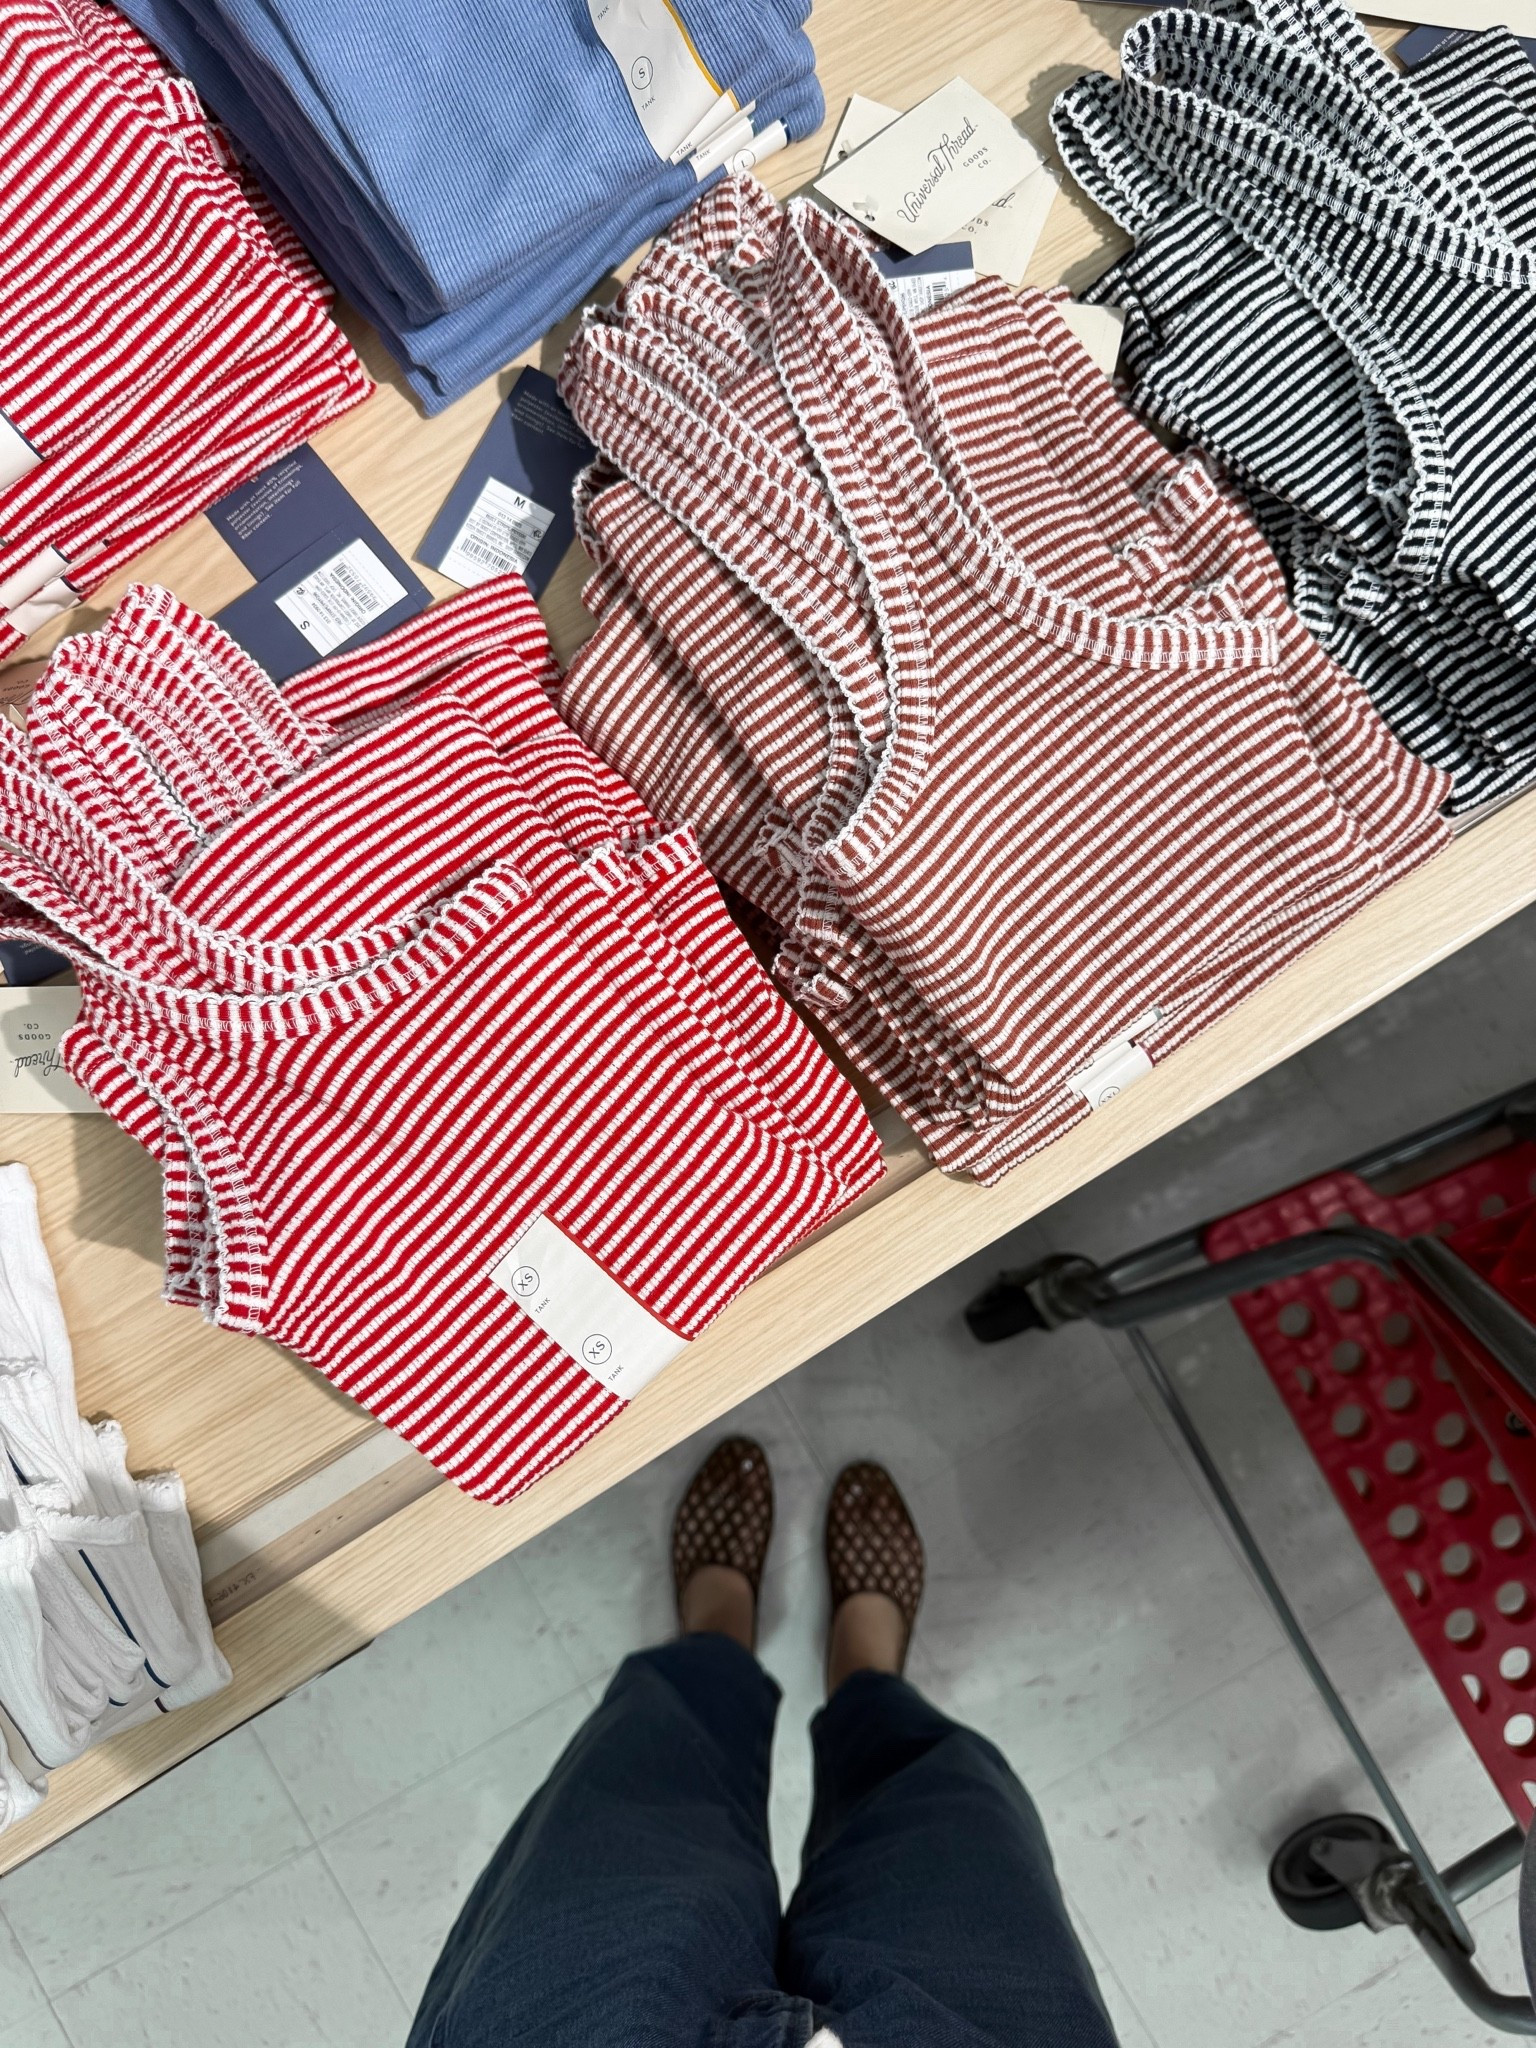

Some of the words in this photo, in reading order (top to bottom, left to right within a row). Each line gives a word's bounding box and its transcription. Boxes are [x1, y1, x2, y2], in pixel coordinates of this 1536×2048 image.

[597, 5, 610, 20] TANK
[638, 67, 647, 79] S
[641, 96, 656, 111] TANK
[675, 141, 693, 157] TANK
[695, 148, 711, 161] TANK
[741, 160, 749, 168] L
[962, 146, 989, 168] GOODS
[977, 158, 992, 169] CO.
[896, 154, 946, 223] Universal
[927, 116, 977, 172] Thread
[225, 508, 240, 521] Made
[238, 499, 250, 510] with
[254, 484, 267, 496] least
[276, 459, 297, 479] recycled
[264, 502, 274, 511] See
[513, 496, 525, 509] M
[300, 620, 310, 631] S
[23, 1022, 39, 1030] CO.
[18, 1033, 51, 1041] GOODS
[517, 1272, 533, 1291] XS
[534, 1297, 551, 1315] TANK
[588, 1340, 605, 1359] XS
[608, 1364, 624, 1382] TANK
